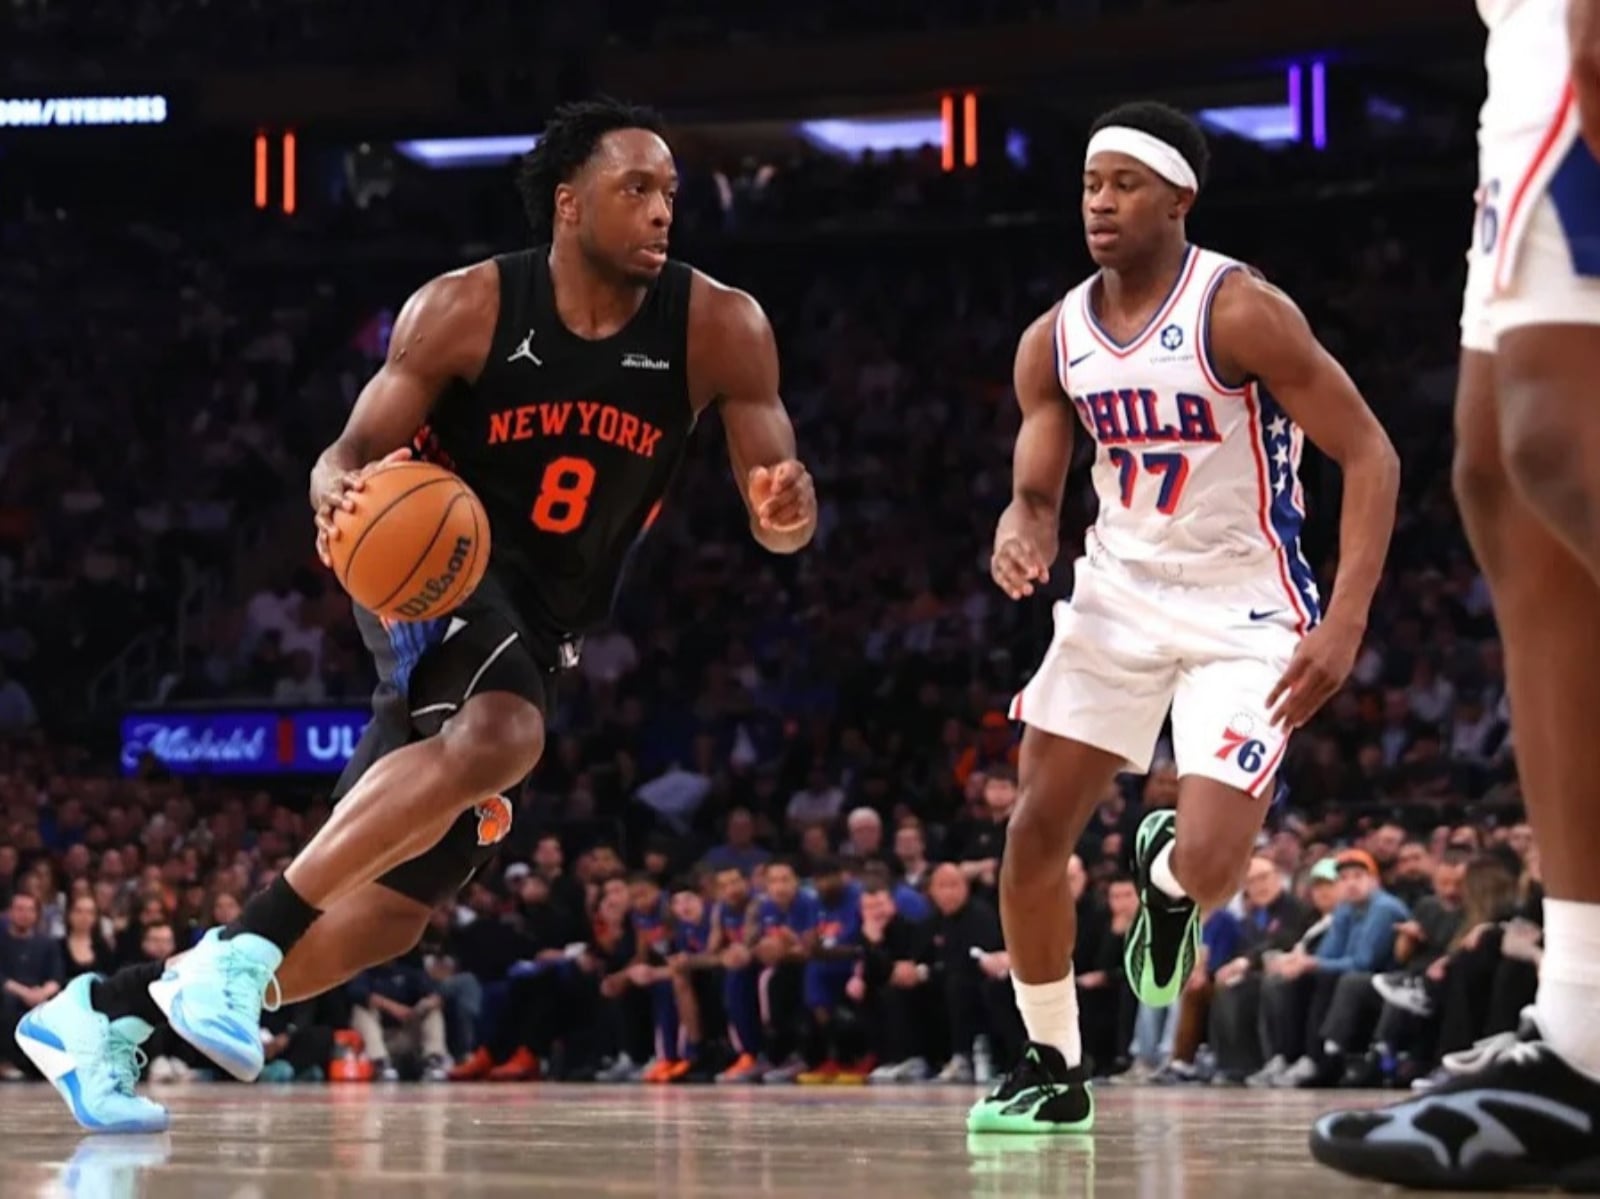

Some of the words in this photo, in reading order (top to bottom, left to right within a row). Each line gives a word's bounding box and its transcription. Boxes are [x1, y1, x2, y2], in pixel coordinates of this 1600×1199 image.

[488, 402, 574, 445] NEW
[577, 401, 662, 457] YORK
[531, 456, 596, 533] 8
[393, 535, 471, 617] Wilson
[1214, 725, 1266, 774] 76
